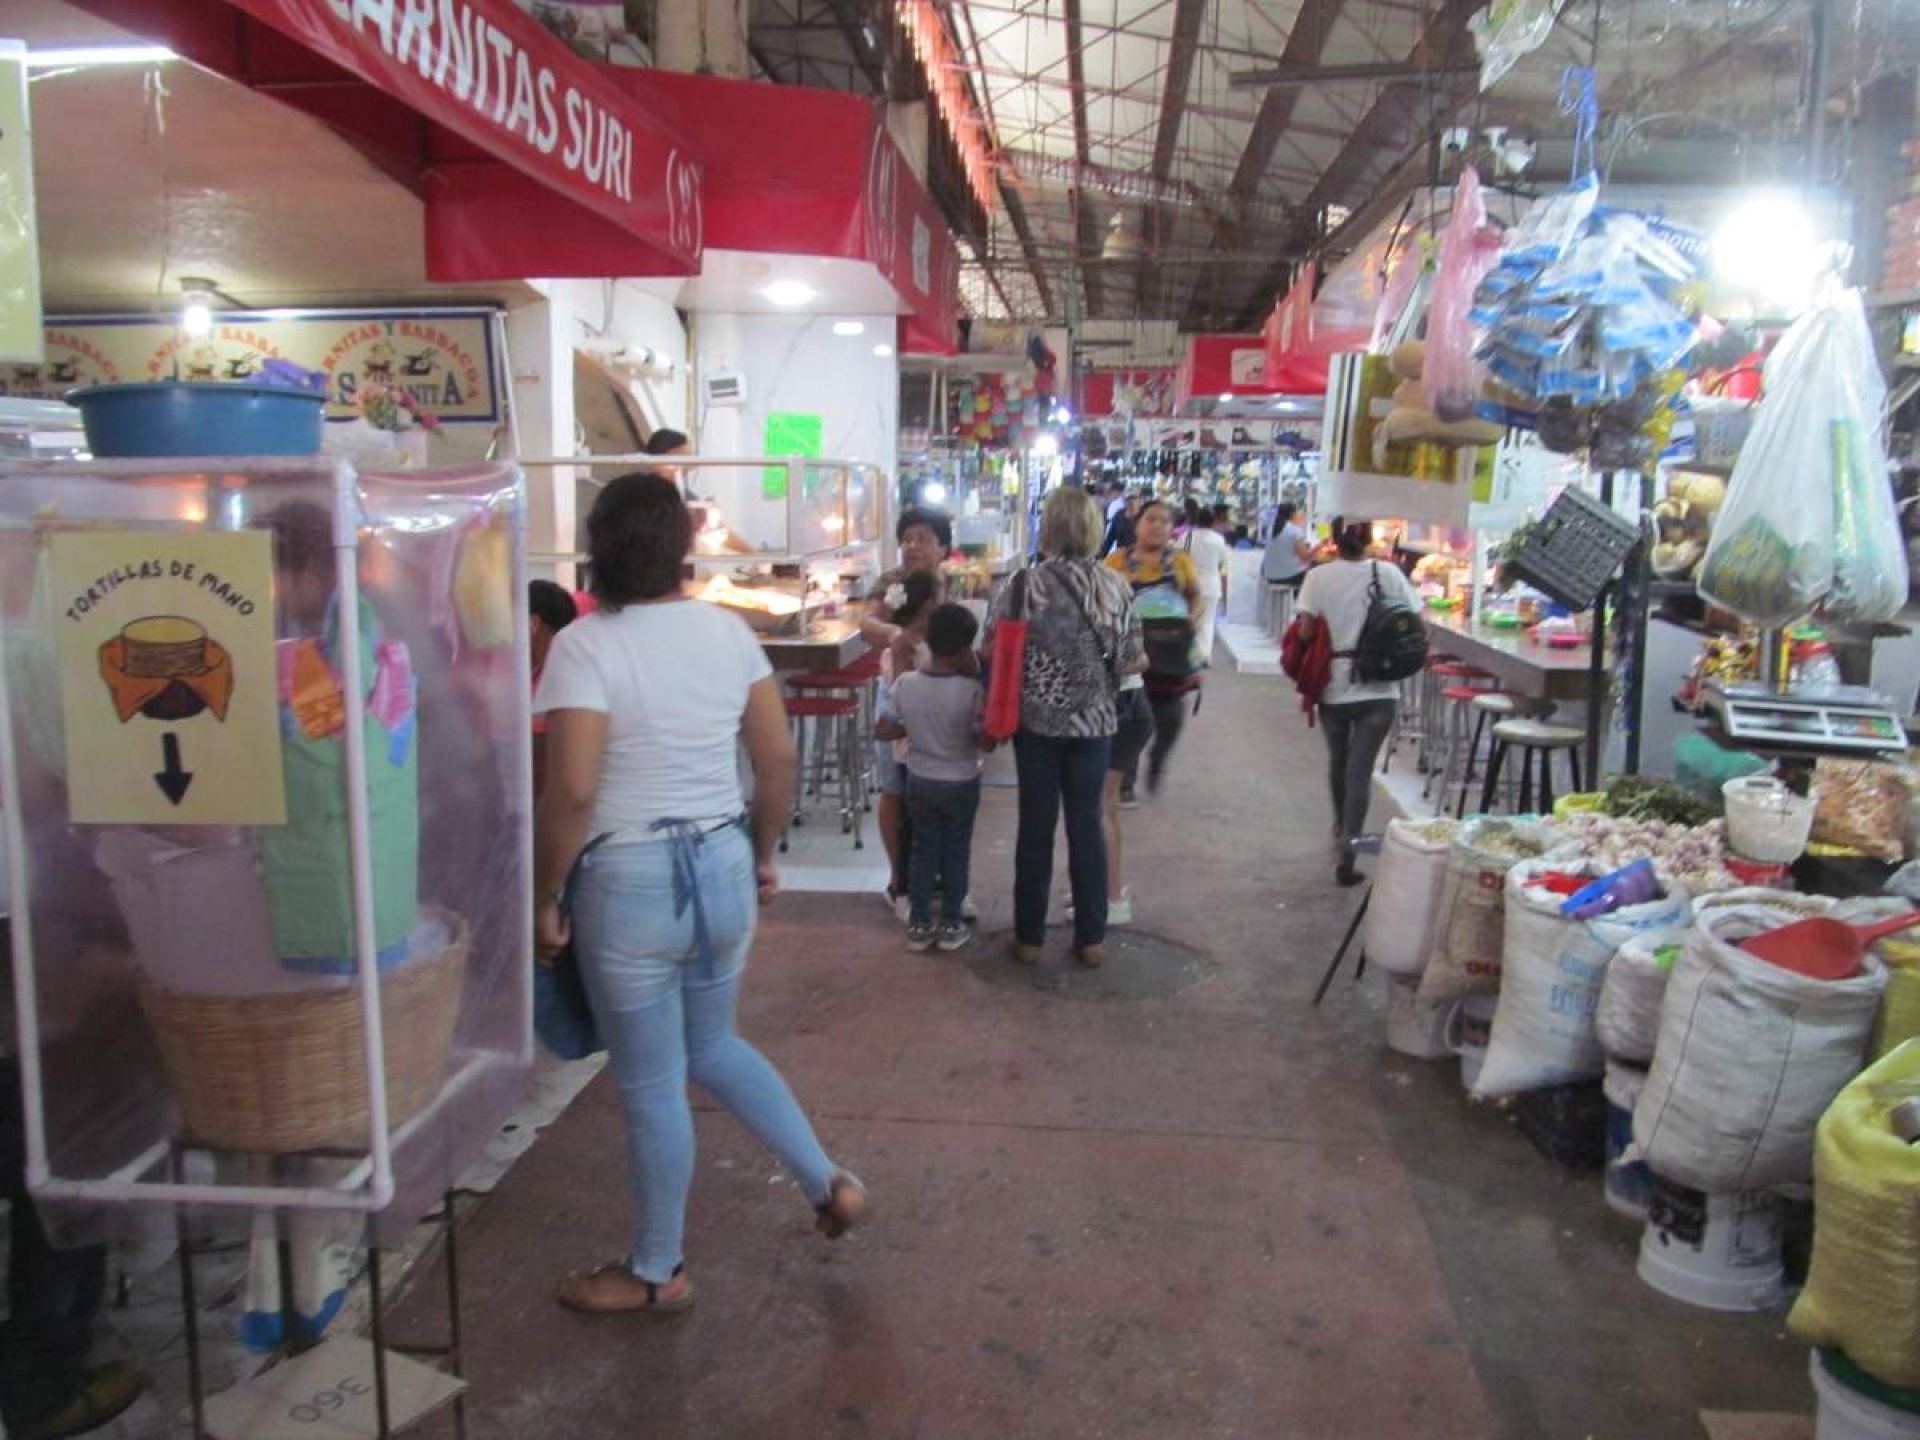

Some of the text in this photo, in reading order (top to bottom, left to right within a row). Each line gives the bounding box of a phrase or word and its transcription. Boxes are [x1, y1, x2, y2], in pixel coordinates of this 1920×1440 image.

[322, 0, 634, 202] ARNITAS SURI
[65, 560, 255, 622] TORTILLAS DE MANO
